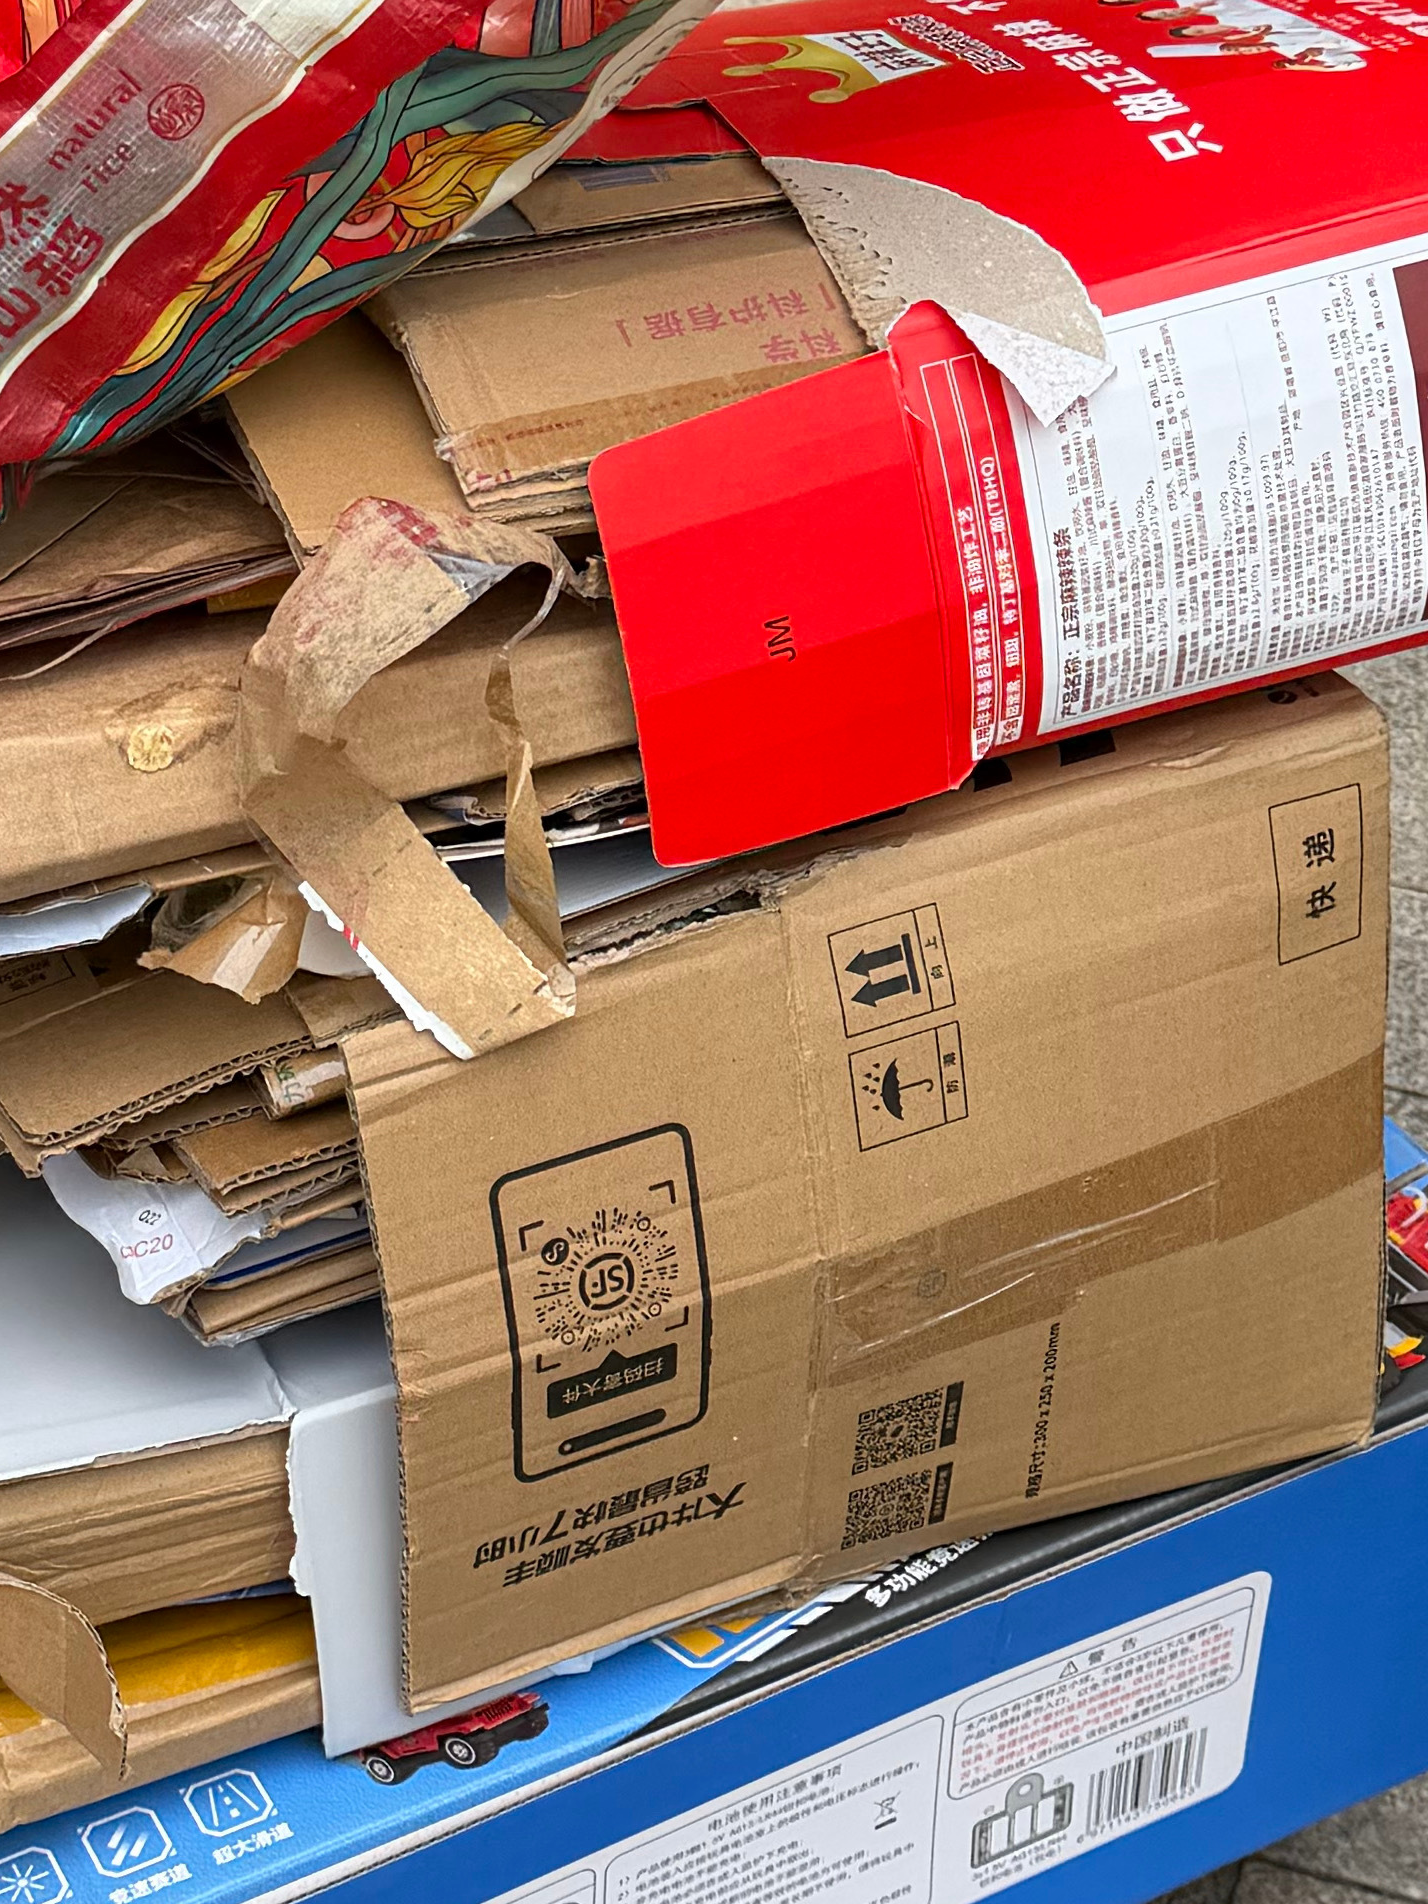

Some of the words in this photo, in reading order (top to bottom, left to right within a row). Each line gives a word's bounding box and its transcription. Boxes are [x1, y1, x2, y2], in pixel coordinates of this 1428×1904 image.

[993, 18, 1224, 163] 只做正宗麻辣
[49, 68, 143, 172] natural
[82, 142, 133, 194] rice
[761, 328, 843, 364] 科学
[765, 615, 797, 661] JM
[1302, 827, 1337, 919] 快递
[924, 933, 948, 981] 向上
[941, 1050, 962, 1096] 防潮
[589, 1264, 625, 1299] SF
[1043, 1321, 1061, 1372] 200mm
[561, 1356, 666, 1405] 扫码寄大件
[1037, 1385, 1054, 1409] 250
[473, 1462, 710, 1569] 跨省最快7小时
[503, 1481, 748, 1588] 大件也要发顺丰
[1114, 1713, 1190, 1759] 中国制造
